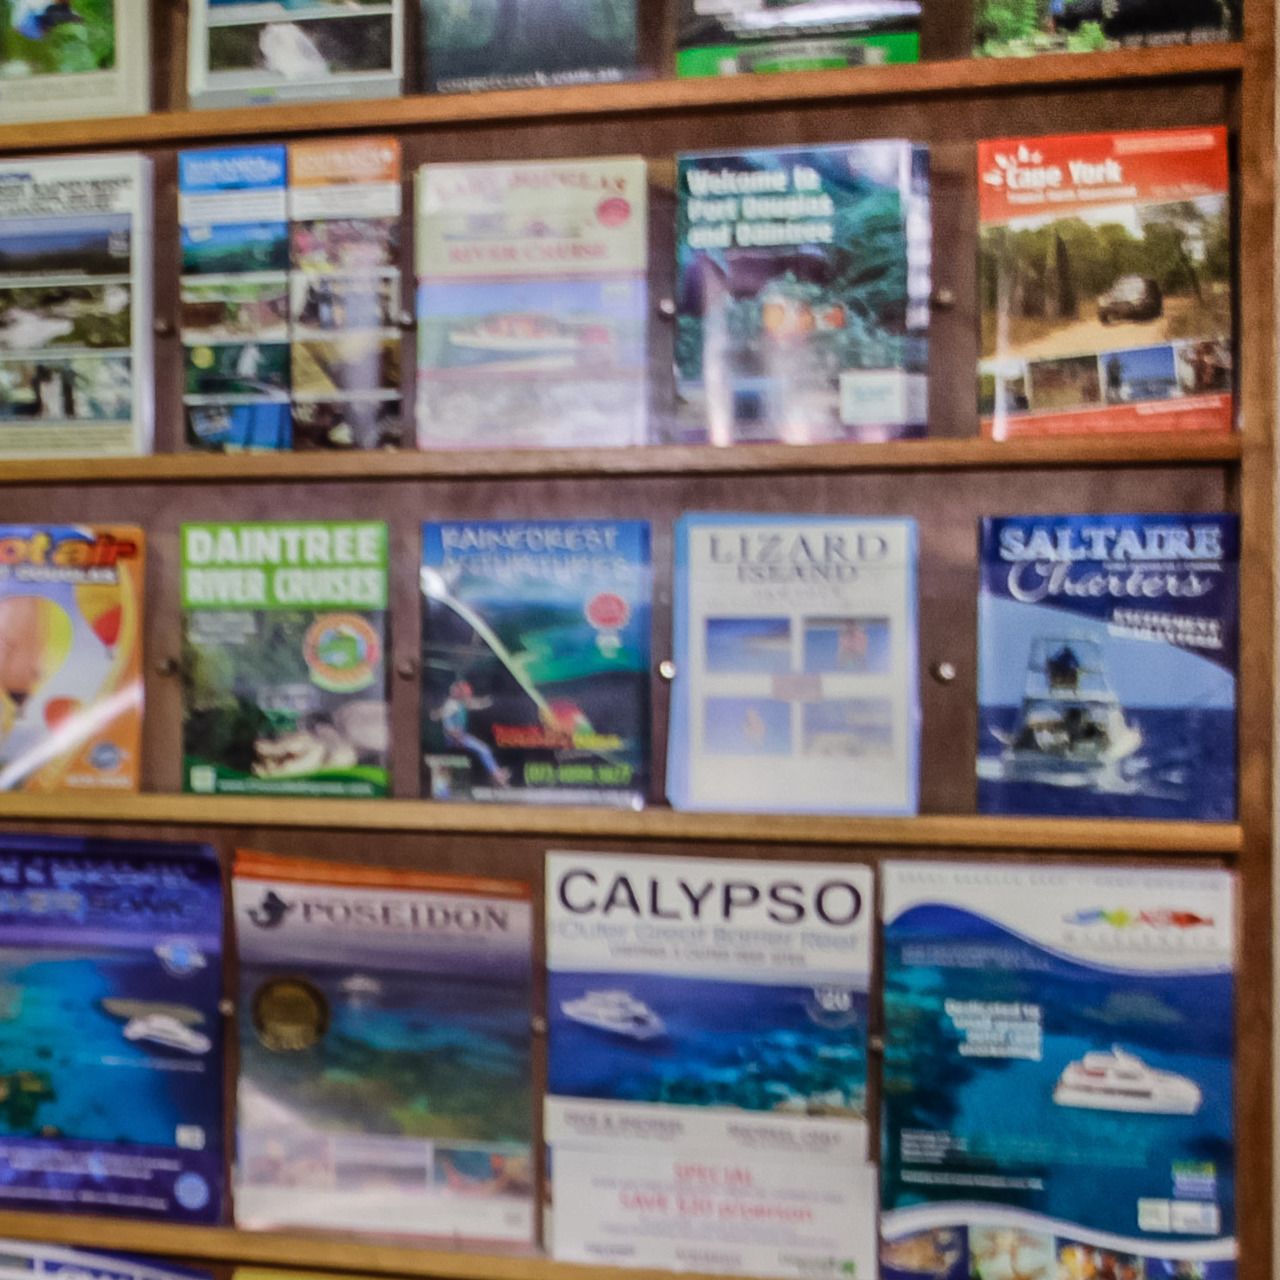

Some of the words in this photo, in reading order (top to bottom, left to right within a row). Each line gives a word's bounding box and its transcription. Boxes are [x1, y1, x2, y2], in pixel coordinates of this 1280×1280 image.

[686, 168, 788, 195] Welcome
[794, 166, 821, 191] to
[1006, 163, 1062, 191] Cape
[1068, 159, 1124, 185] York
[686, 197, 738, 222] Port
[741, 191, 835, 219] Douglas
[686, 222, 732, 248] and
[736, 219, 834, 246] Daintree
[54, 532, 138, 567] air
[187, 526, 381, 565] DAINTREE
[440, 526, 620, 551] RAINFOREST
[707, 531, 889, 567] LIZARD
[999, 525, 1223, 562] SALTAIRE
[187, 568, 266, 601] RIVER
[272, 568, 383, 604] CRUISES
[735, 562, 859, 586] ISLAND
[1007, 558, 1217, 603] Charters
[557, 868, 863, 927] CALYPSO
[297, 901, 509, 934] POSEIDON
